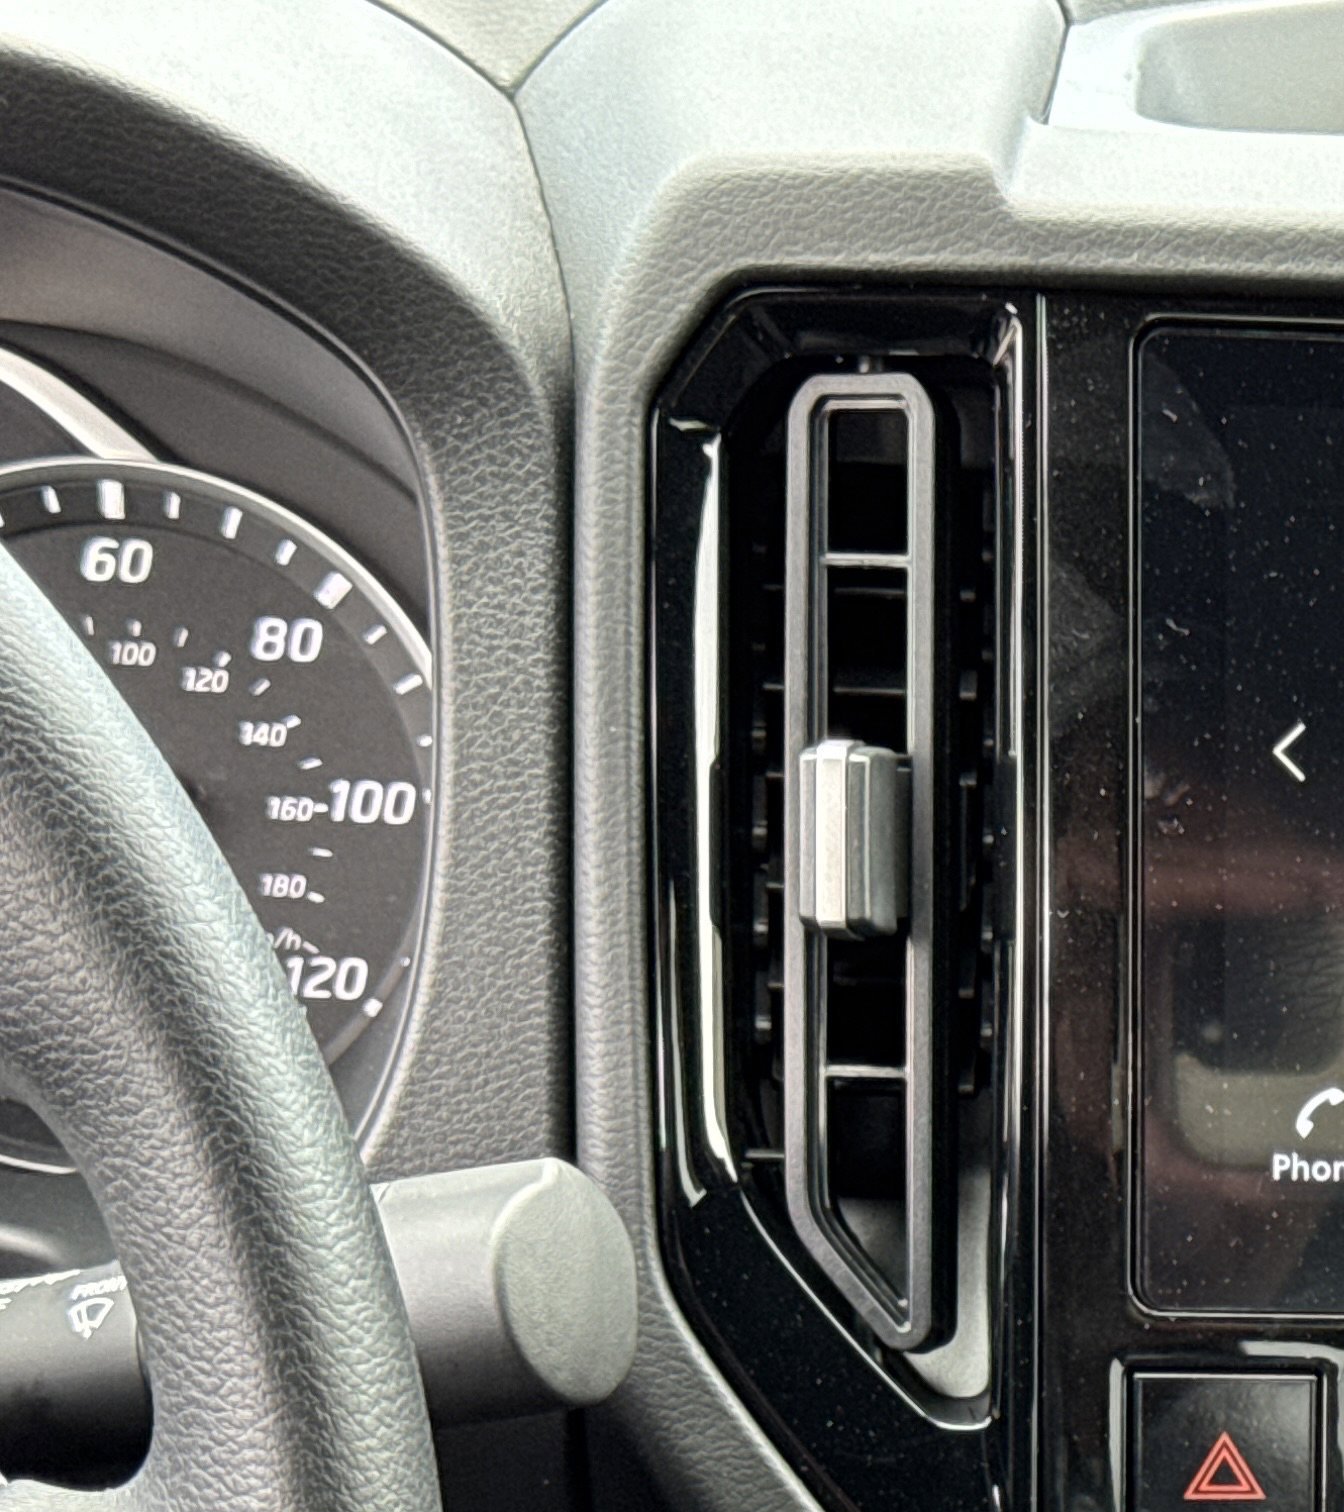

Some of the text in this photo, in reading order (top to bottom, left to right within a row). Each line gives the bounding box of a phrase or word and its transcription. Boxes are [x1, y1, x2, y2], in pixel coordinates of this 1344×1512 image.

[81, 536, 154, 583] 60
[250, 616, 324, 662] 80
[108, 640, 157, 666] 100
[181, 667, 230, 692] 120
[239, 720, 288, 746] 140
[266, 796, 314, 822] 160
[329, 779, 417, 825] 100
[259, 873, 307, 898] 180
[286, 956, 369, 1001] 120
